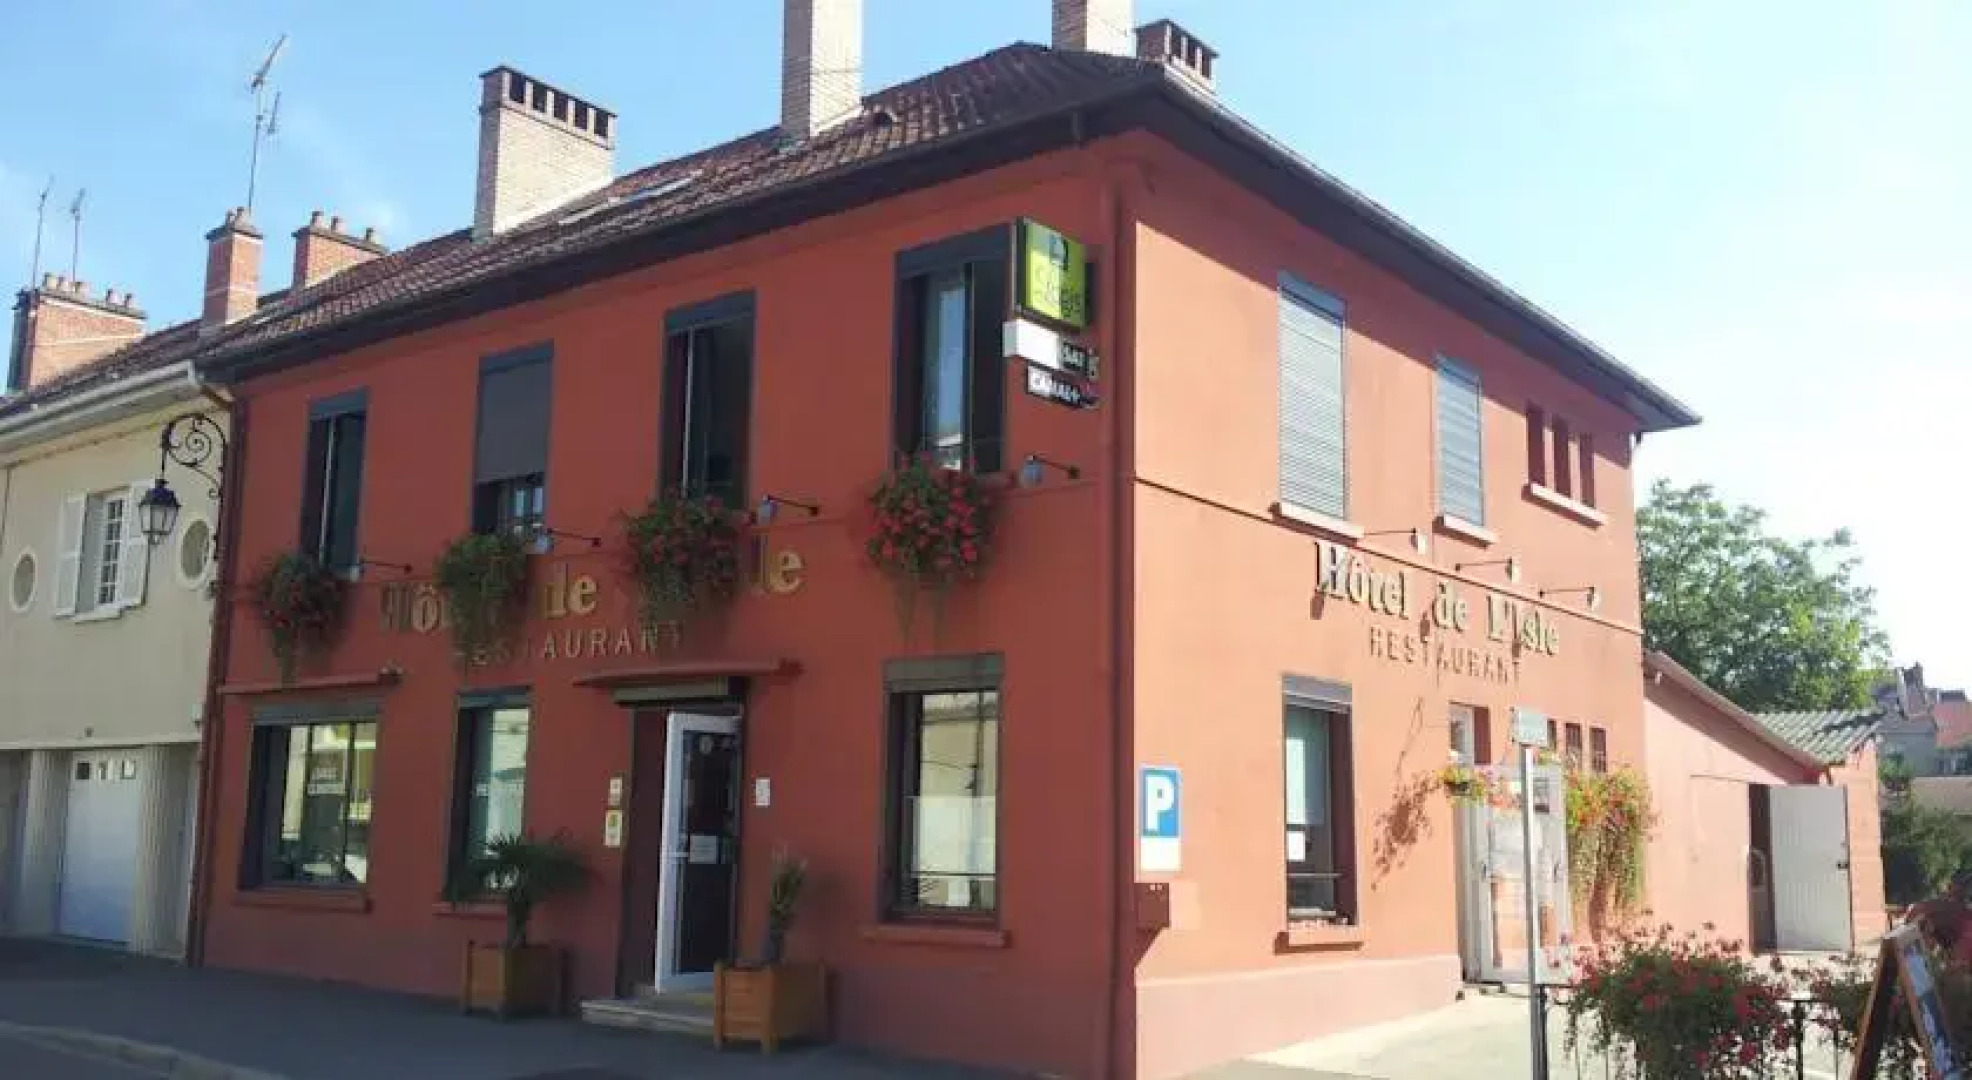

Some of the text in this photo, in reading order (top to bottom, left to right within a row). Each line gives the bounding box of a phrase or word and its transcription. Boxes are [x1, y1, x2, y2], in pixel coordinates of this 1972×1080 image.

[543, 562, 599, 619] de
[1315, 541, 1410, 620] Hôtel
[1432, 580, 1468, 634] de
[1370, 626, 1521, 686] RESTAURANT
[1144, 774, 1175, 831] P
